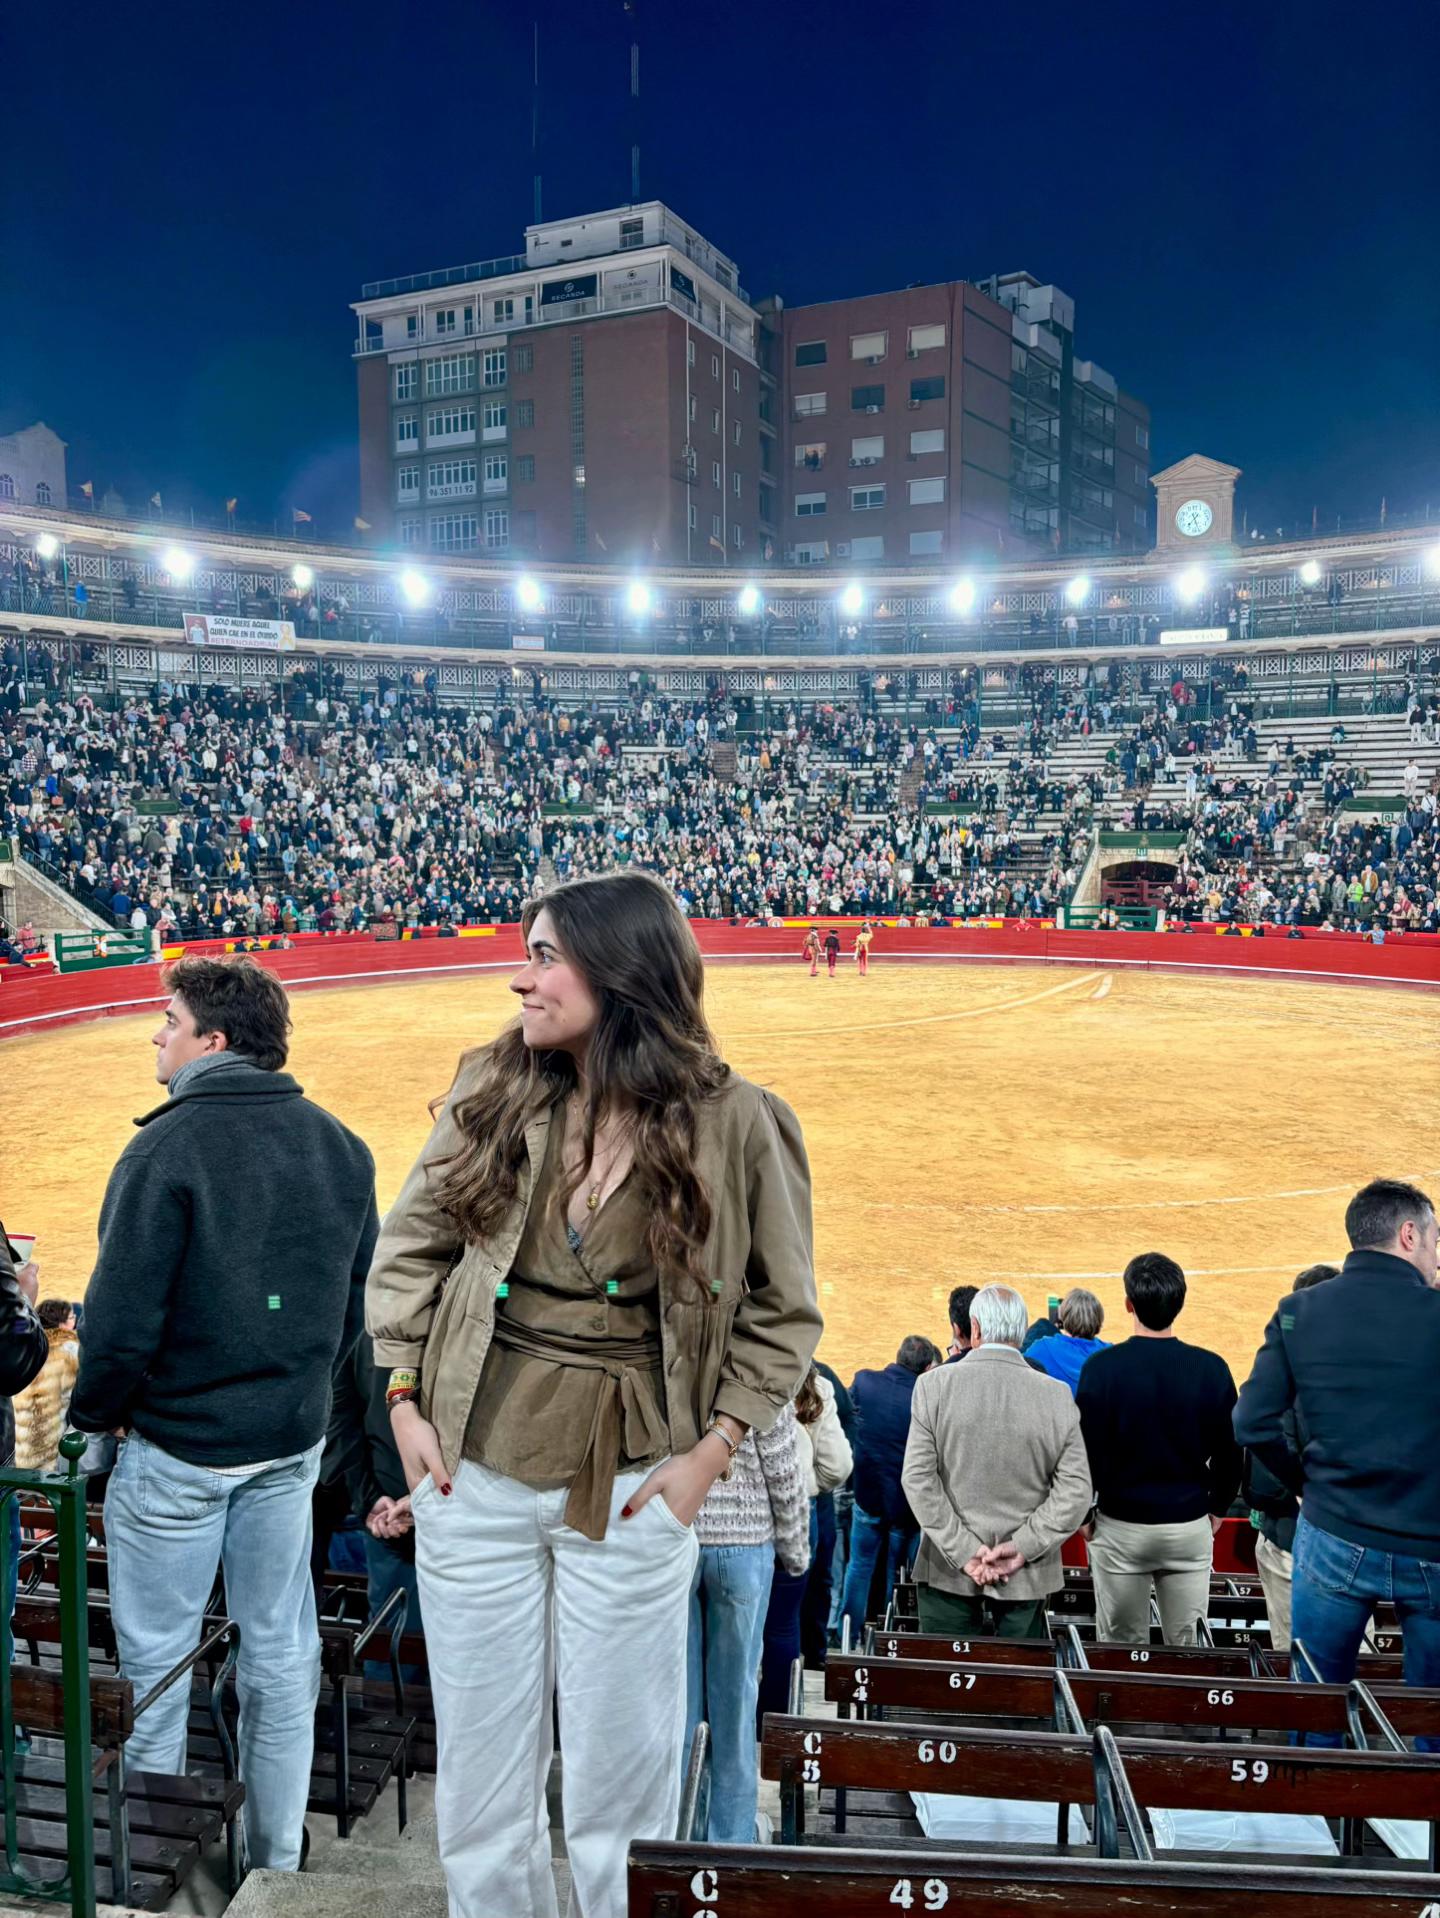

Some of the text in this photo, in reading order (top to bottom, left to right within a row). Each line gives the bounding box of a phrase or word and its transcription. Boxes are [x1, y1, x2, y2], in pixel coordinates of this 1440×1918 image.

[440, 487, 451, 496] 351
[455, 486, 462, 494] 11
[465, 485, 473, 493] 92
[214, 617, 270, 629] SOLO MUERE AQUEL
[210, 628, 227, 636] QUIEN
[229, 629, 239, 637] CAE
[241, 630, 248, 638] EN
[1240, 1587, 1251, 1595] 57
[1064, 1594, 1077, 1603] 59
[1234, 1633, 1250, 1643] 58
[1378, 1637, 1393, 1648] 57
[887, 1639, 898, 1651] C
[952, 1641, 970, 1652] 61
[1130, 1650, 1149, 1661] 60
[854, 1668, 868, 1685] C
[949, 1673, 976, 1690] 67
[852, 1686, 868, 1701] 4
[1207, 1689, 1234, 1706] 66
[803, 1732, 822, 1755] C
[918, 1740, 957, 1764] 60
[801, 1759, 821, 1782] 5
[1231, 1760, 1269, 1783] 59
[690, 1870, 719, 1902] C
[889, 1878, 949, 1911] 49
